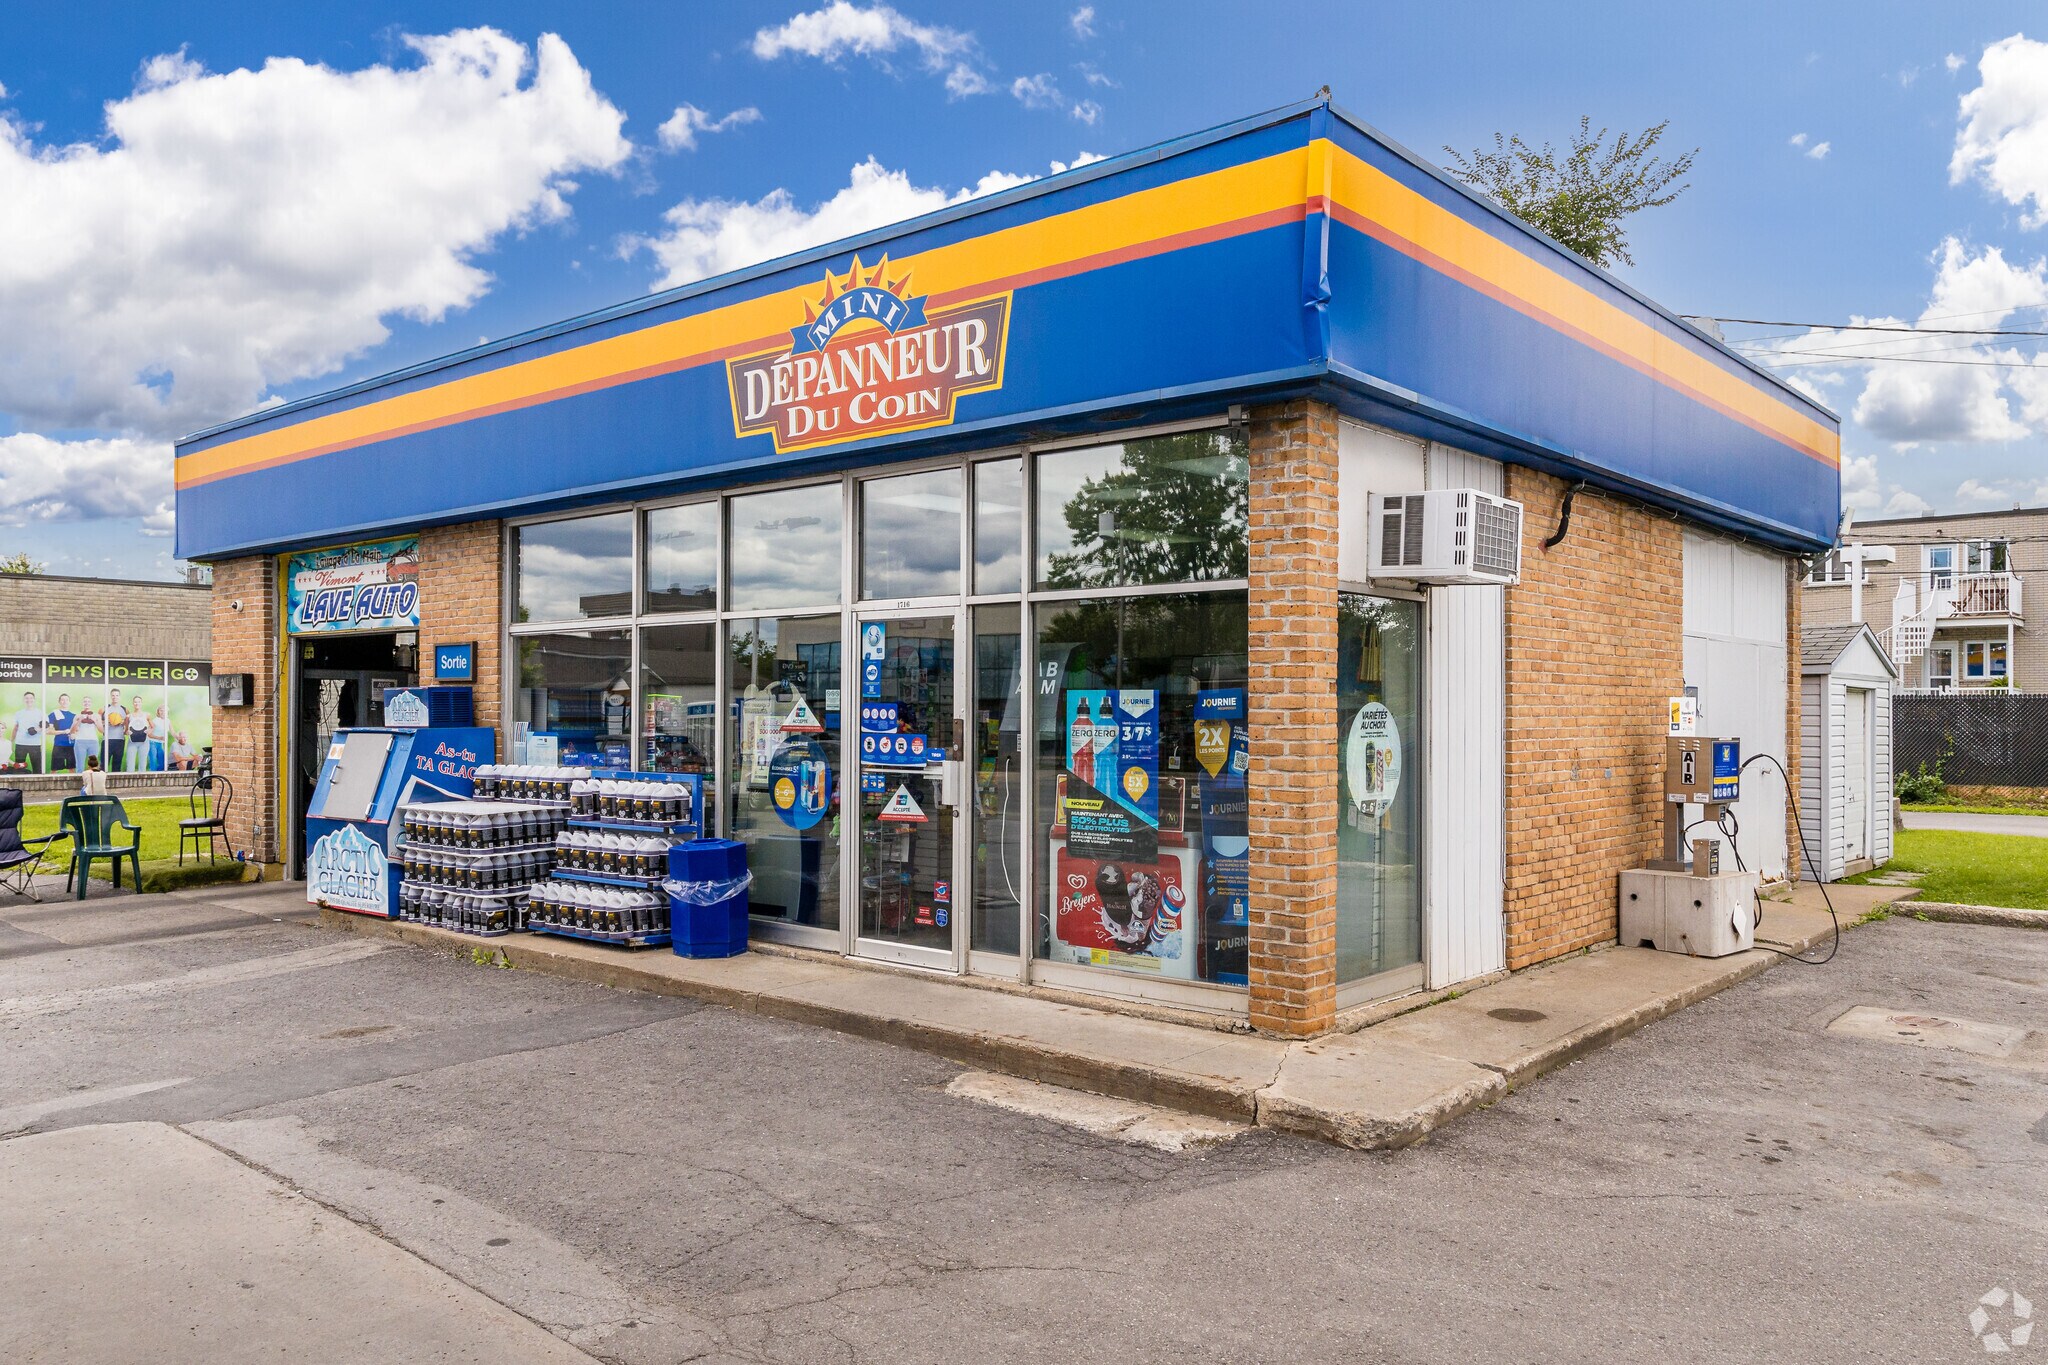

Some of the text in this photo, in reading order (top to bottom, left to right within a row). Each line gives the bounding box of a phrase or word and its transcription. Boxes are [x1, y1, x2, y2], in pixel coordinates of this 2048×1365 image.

[813, 291, 901, 348] MINI
[744, 318, 991, 421] DÉPANNEUR
[315, 570, 364, 587] Vimont
[301, 581, 418, 627] LAVE AUTO
[441, 655, 467, 669] Sortie
[1202, 697, 1237, 707] JOURNIE
[1362, 708, 1388, 720] VARIÉTÉS
[1072, 729, 1092, 737] ZERO
[1094, 729, 1116, 737] ZERO
[1361, 720, 1387, 730] AU CHOIX
[1199, 727, 1225, 746] 2X
[435, 742, 476, 762] As-tu
[415, 755, 478, 780] TA GLAC
[1683, 752, 1693, 784] AIR
[1128, 776, 1144, 788] 5X
[1209, 802, 1246, 815] JOURNIE
[1071, 816, 1129, 827] 50% PLUS
[318, 839, 380, 876] ARCTIC
[319, 871, 380, 901] GLACIER
[1060, 893, 1095, 915] Breyers
[1215, 935, 1248, 951] JOURN
